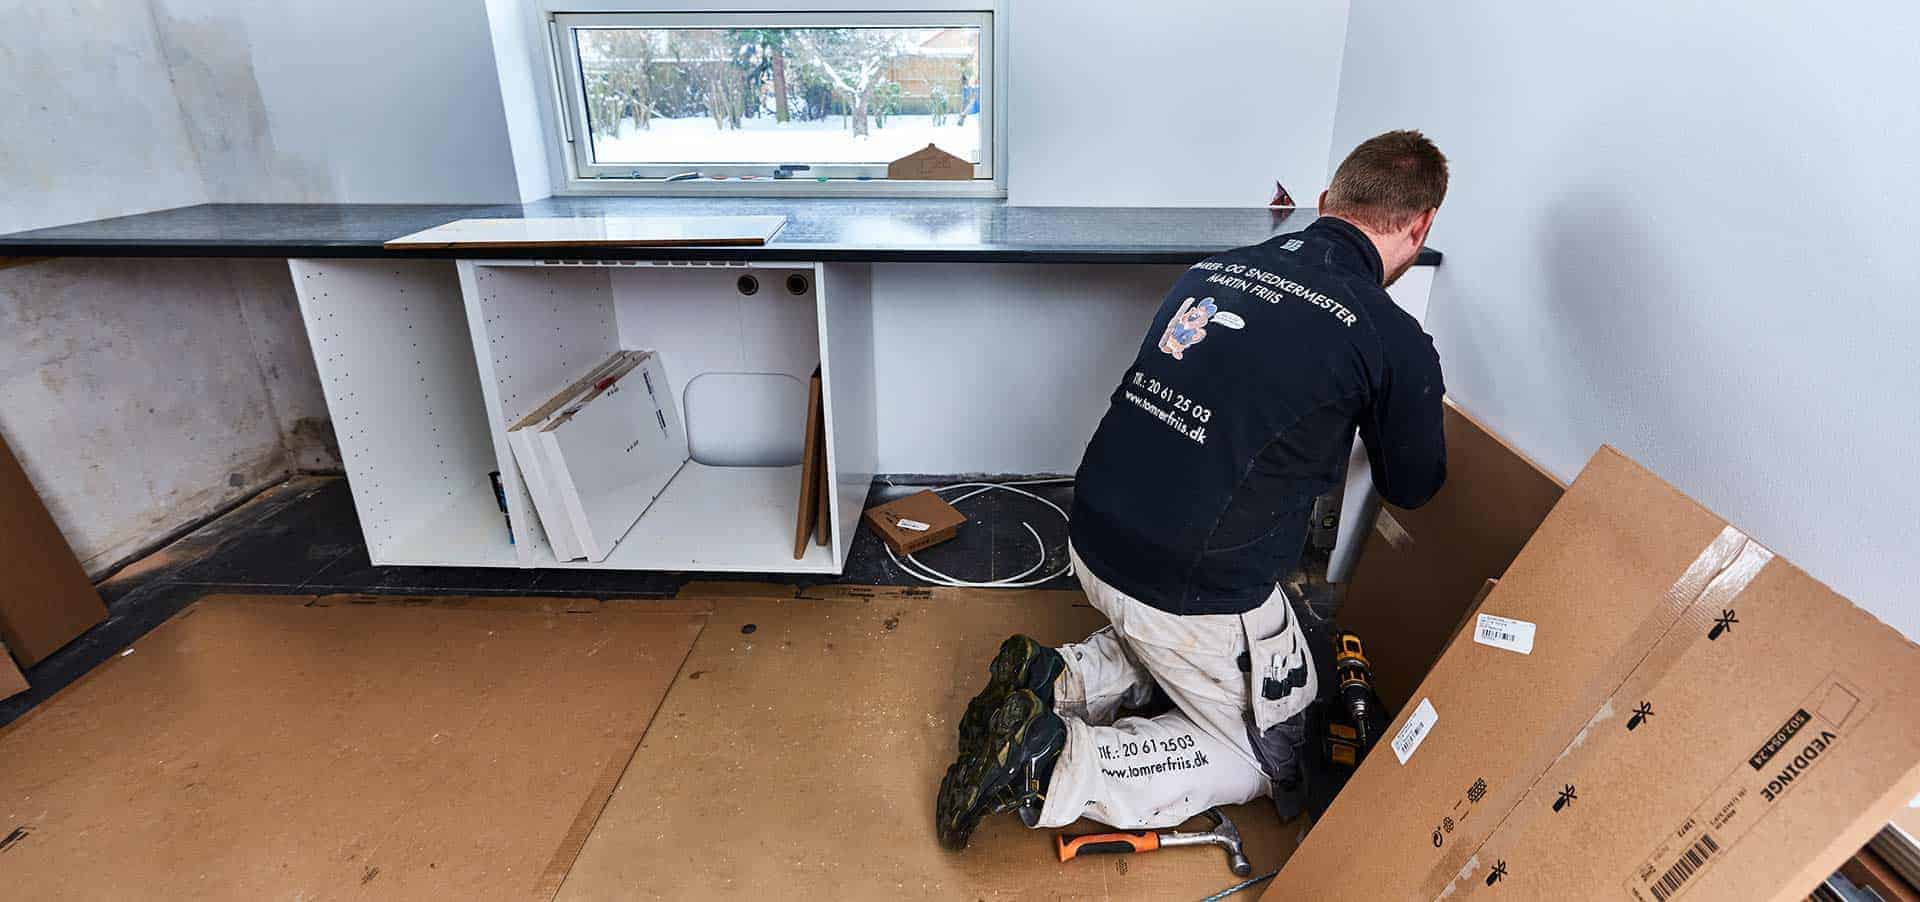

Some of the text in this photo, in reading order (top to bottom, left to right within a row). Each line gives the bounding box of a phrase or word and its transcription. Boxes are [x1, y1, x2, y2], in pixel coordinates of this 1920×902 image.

[1206, 272, 1284, 304] MARTIN FRIIS
[1225, 264, 1248, 274] OG
[1244, 267, 1358, 328] SNEDKERMESTER
[1147, 379, 1161, 394] 20
[1160, 387, 1174, 403] 61
[1174, 395, 1192, 412] 25
[1192, 405, 1212, 423] 03
[1122, 742, 1138, 757] 20
[1142, 739, 1157, 754] 61
[1760, 731, 1836, 802] VEDDINGE
